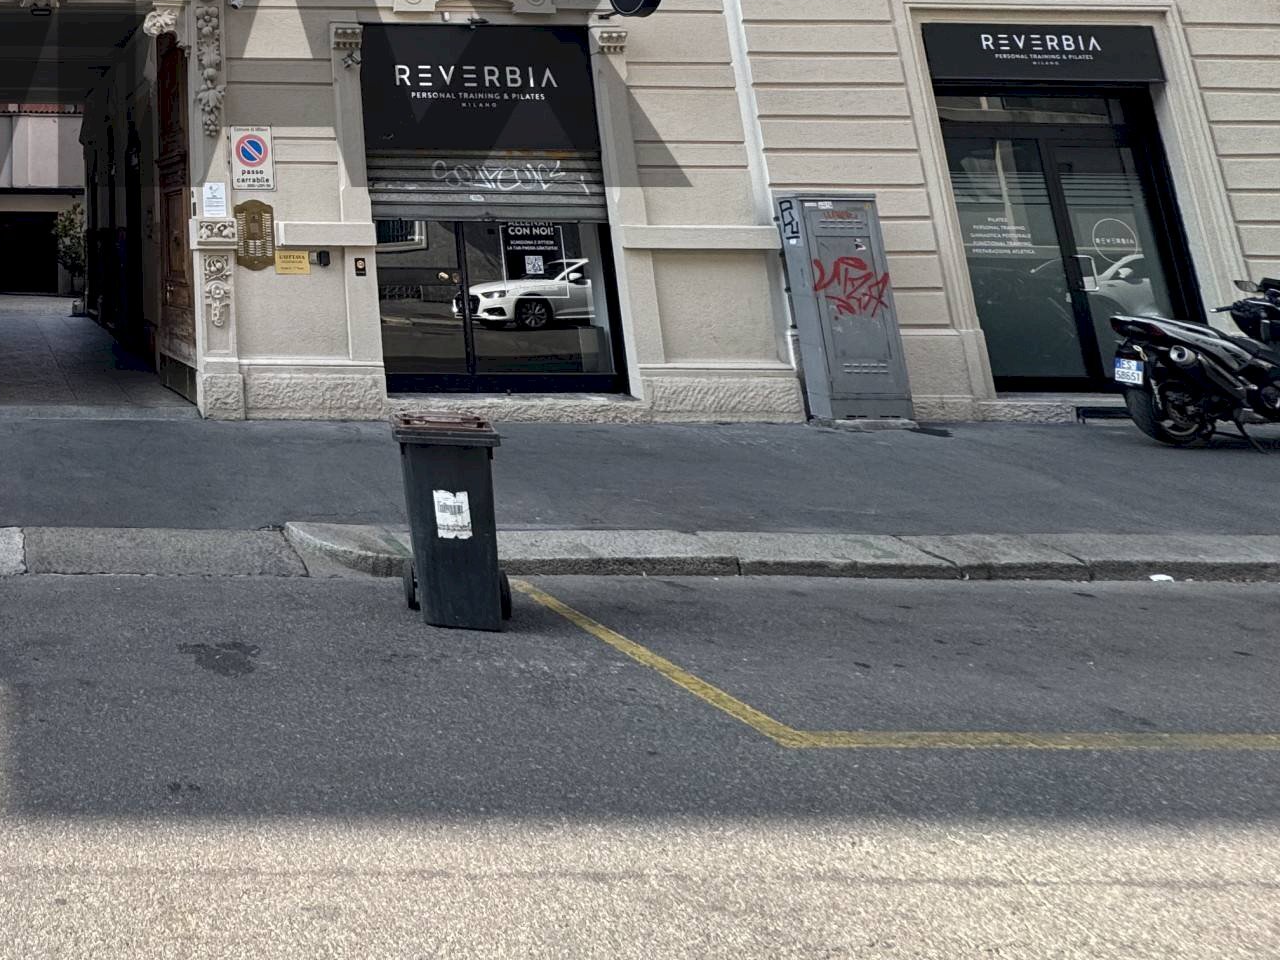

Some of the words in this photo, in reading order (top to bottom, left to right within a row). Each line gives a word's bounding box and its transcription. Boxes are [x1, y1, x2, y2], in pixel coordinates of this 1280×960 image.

[980, 34, 1101, 51] REVERBIA
[394, 64, 558, 88] REVERBIA
[458, 92, 501, 100] TRAINING
[508, 227, 530, 235] CON
[532, 227, 554, 235] NOI!
